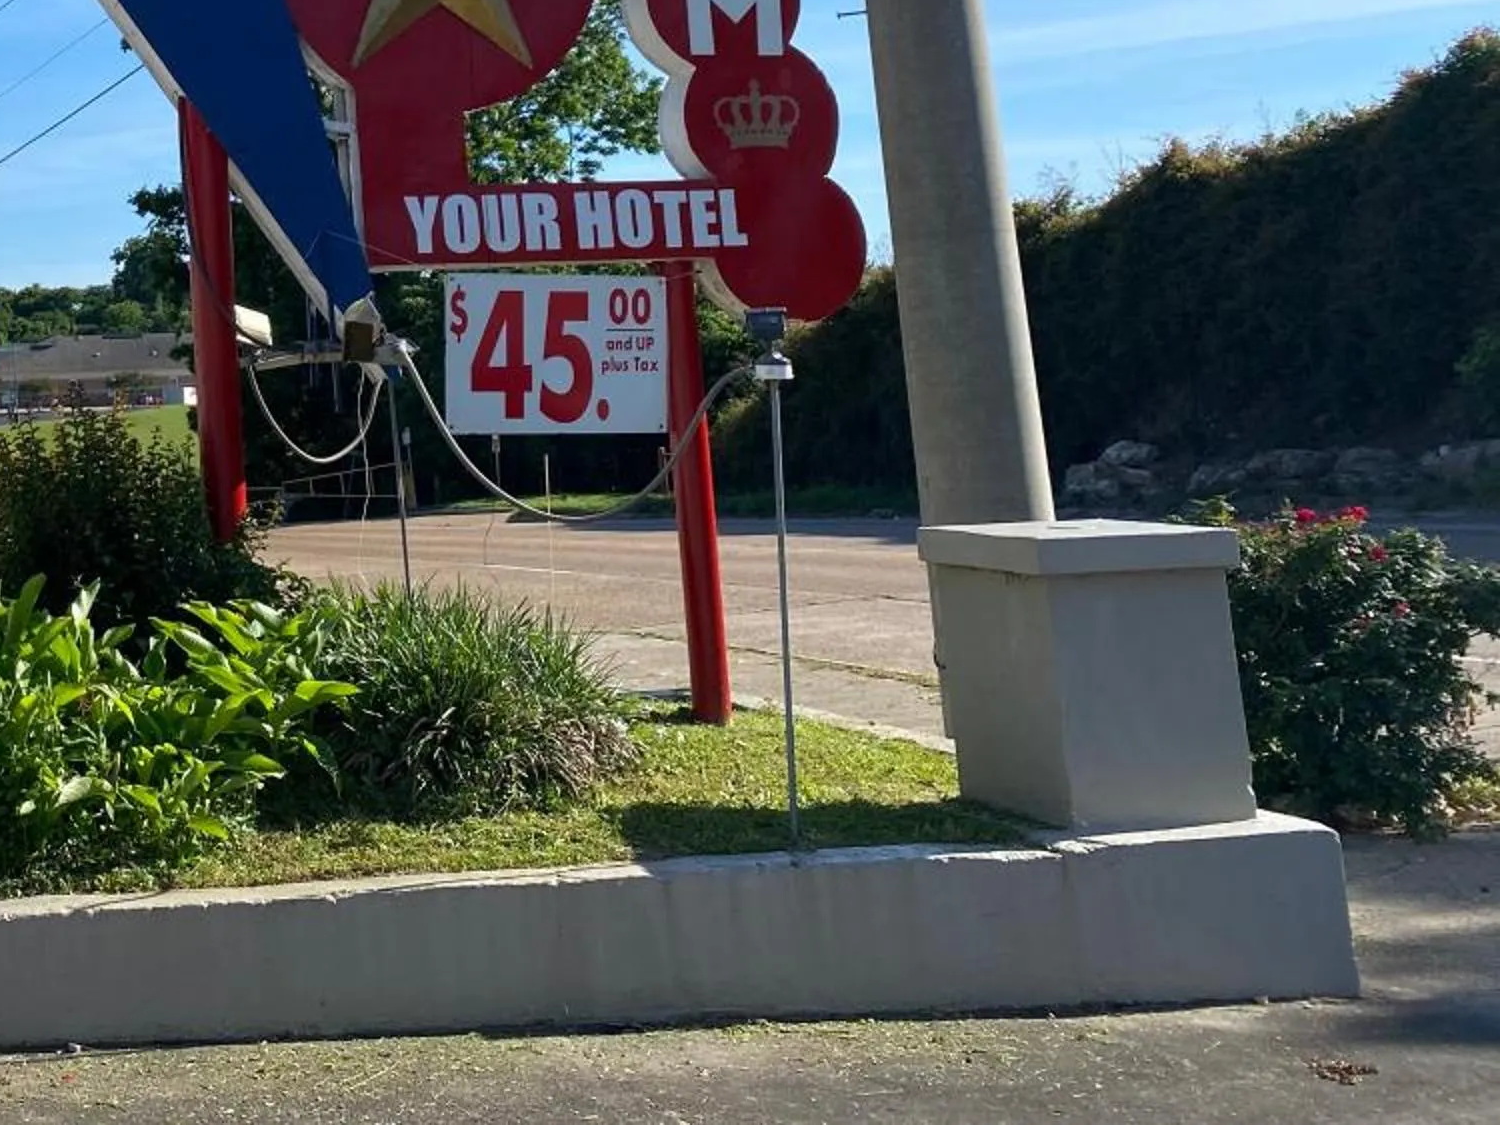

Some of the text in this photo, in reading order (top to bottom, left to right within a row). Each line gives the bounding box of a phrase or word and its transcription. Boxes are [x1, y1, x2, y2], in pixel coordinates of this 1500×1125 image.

[404, 189, 748, 253] YOUR HOTEL
[606, 336, 655, 351] and UP
[601, 356, 659, 375] plus Tax
